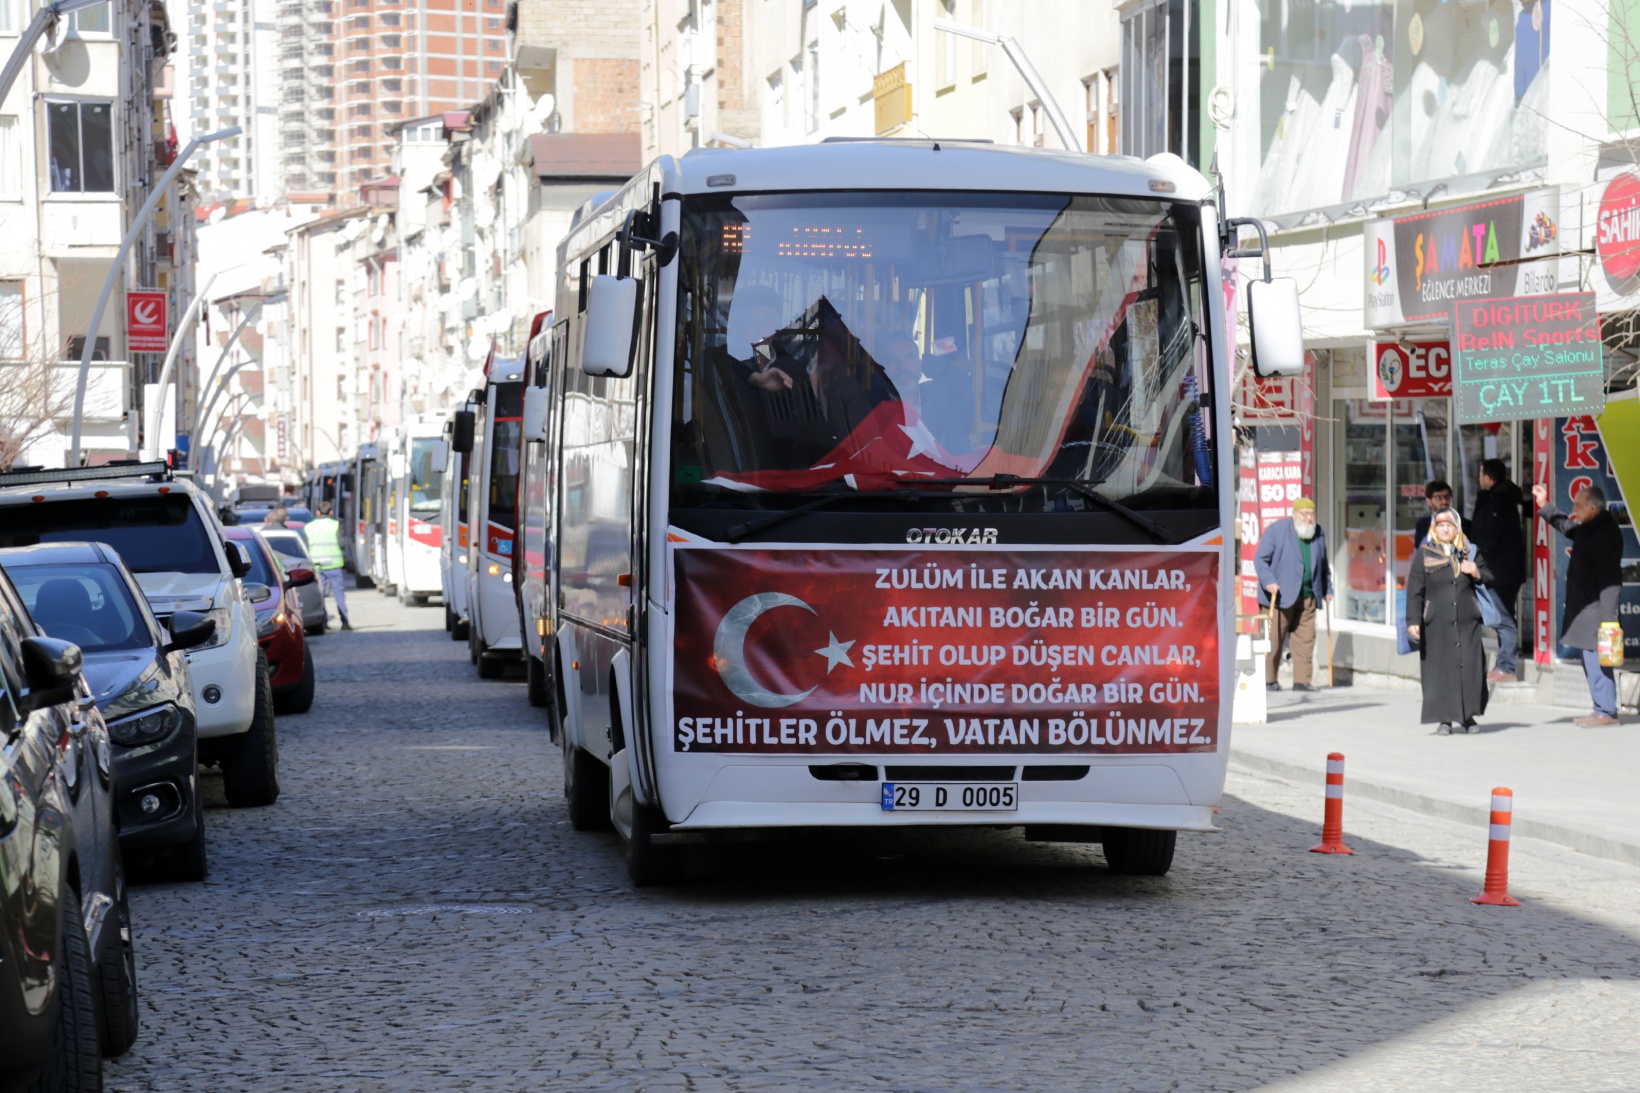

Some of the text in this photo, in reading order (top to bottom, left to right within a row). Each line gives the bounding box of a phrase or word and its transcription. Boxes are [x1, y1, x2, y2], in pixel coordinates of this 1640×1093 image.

[1415, 219, 1500, 292] ŞAMATA
[1422, 270, 1491, 302] EĞLENCE MERKEZİ
[1524, 267, 1555, 294] Bilardo
[1472, 300, 1582, 328] DİGİTÜRK
[1523, 327, 1599, 351] Sports
[1465, 354, 1507, 371] Teras
[1511, 352, 1541, 372] Çay
[1544, 350, 1595, 366] Salonu
[1479, 378, 1585, 414] ÇAY 1TL
[1261, 484, 1284, 502] 50
[905, 528, 999, 546] OTOKAR
[1241, 511, 1259, 545] 50
[875, 563, 1192, 592] ZULÜM İLE AKAN KANLAR,
[883, 601, 1184, 629] AKITANI BOĞAR BİR GÜN.
[862, 639, 1201, 672] ŞEHİT OLUP DÜŞEN CANLAR,
[860, 677, 1205, 709] NUR İÇİNDE DOĞAR BİR GÜN.
[678, 711, 1212, 752] ŞEHİTLER ÖLMEZ, VATAN BÖLÜNMEZ.
[895, 786, 1014, 807] 29 D 0005
